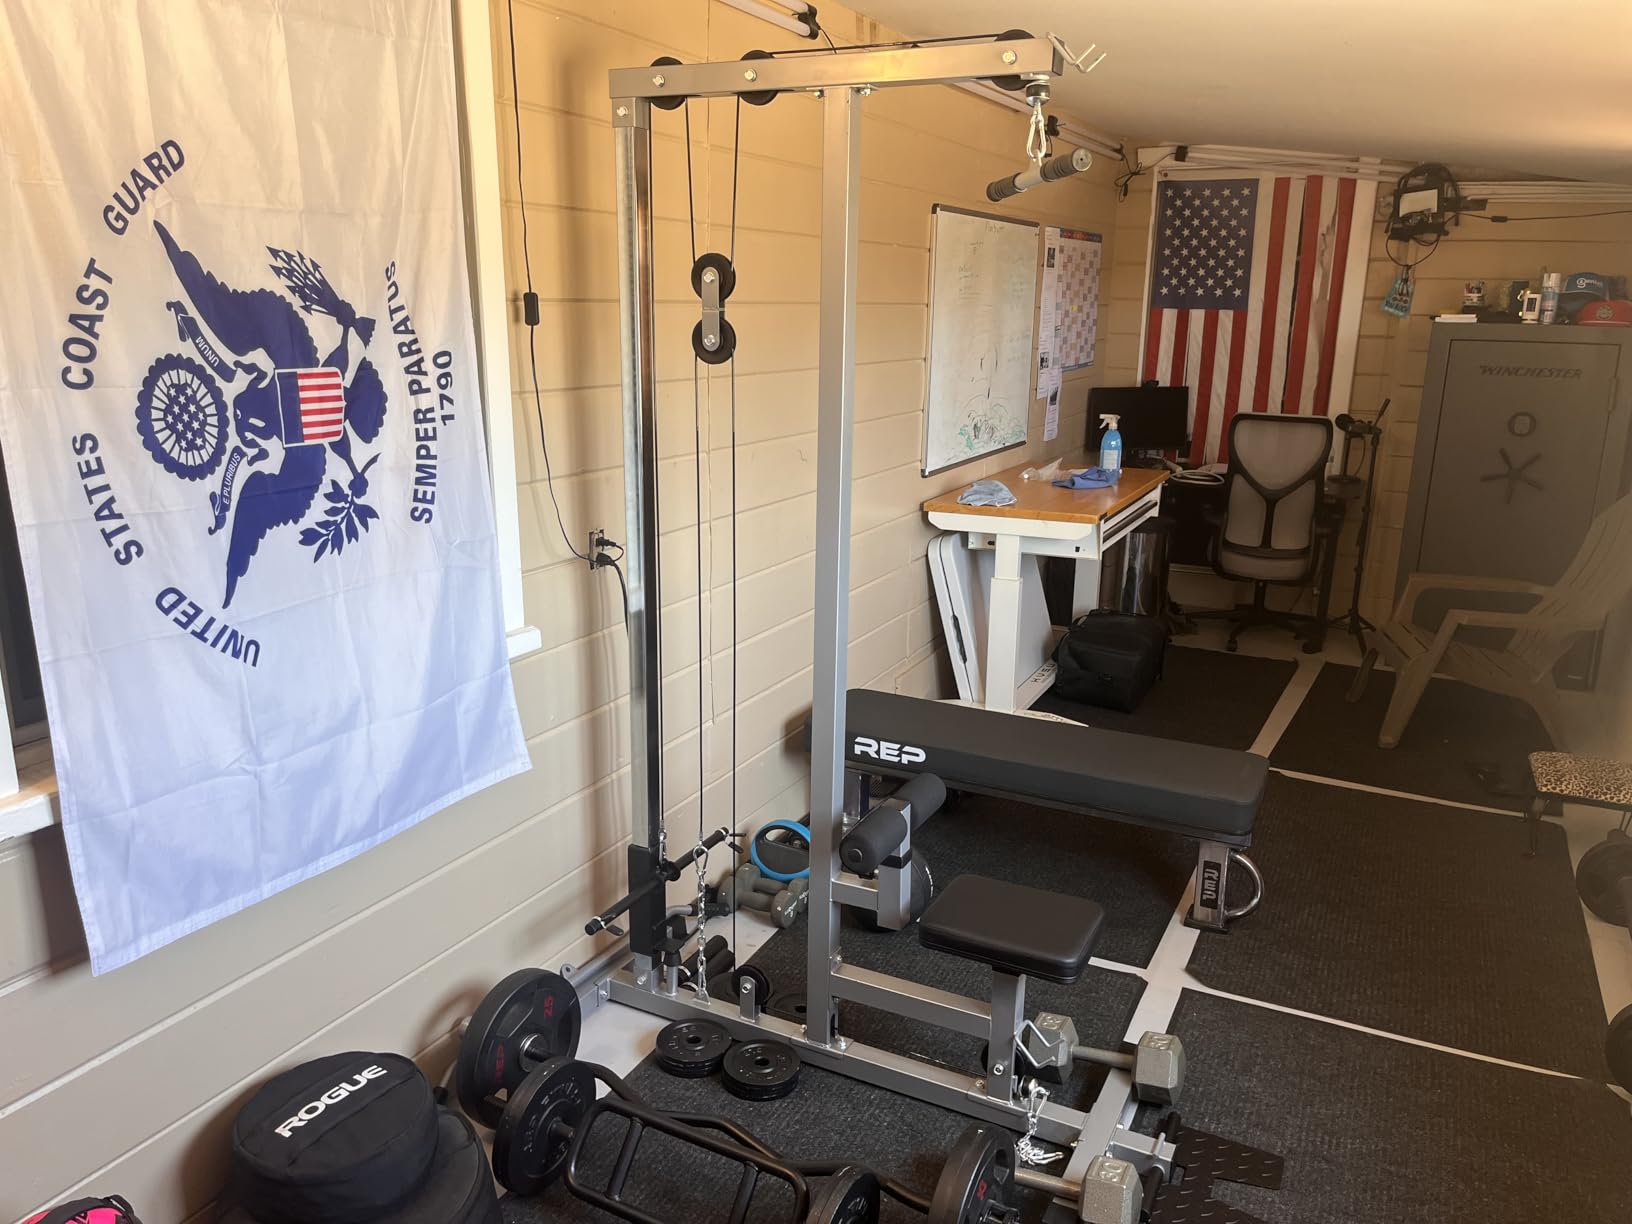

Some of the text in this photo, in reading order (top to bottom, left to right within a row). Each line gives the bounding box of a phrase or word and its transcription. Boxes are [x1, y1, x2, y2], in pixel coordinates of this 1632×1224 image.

[195, 335, 220, 368] UNUM
[385, 260, 437, 524] SEMPER PARATUS
[432, 350, 455, 426] 1790
[1480, 365, 1583, 380] WINCHESTER
[61, 139, 260, 668] UNITED STATES COAST GUARD
[223, 452, 241, 497] PLURIBUS
[854, 735, 927, 765] REP
[1202, 868, 1219, 900] REP
[273, 1064, 389, 1139] ROGUE
[1099, 1162, 1123, 1182] 30
